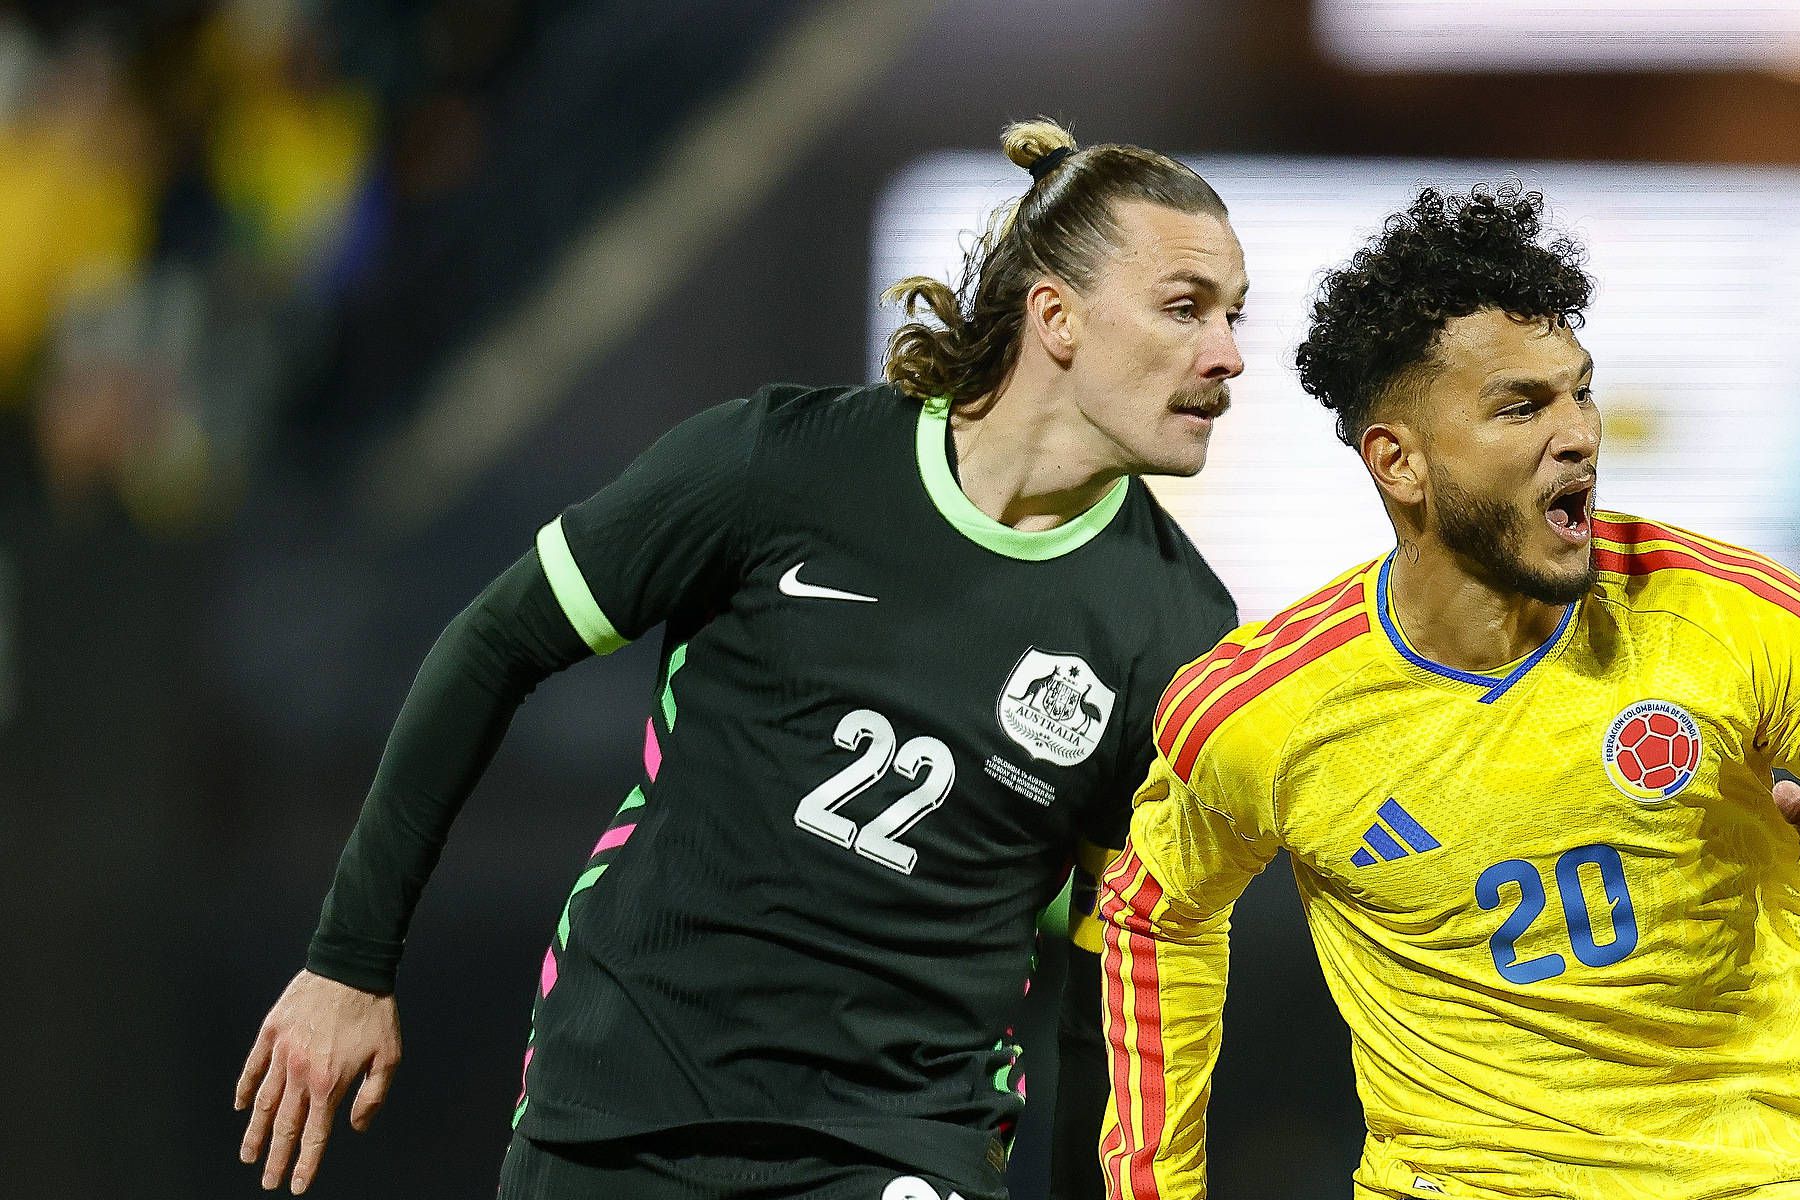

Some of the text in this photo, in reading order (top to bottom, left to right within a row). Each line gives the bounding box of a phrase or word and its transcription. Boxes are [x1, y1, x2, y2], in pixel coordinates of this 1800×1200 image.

[1016, 705, 1082, 747] AUSTRALIA
[1623, 703, 1670, 720] COLOMBIANA
[1670, 707, 1680, 717] DE
[794, 709, 956, 875] 22
[1475, 844, 1639, 985] 20
